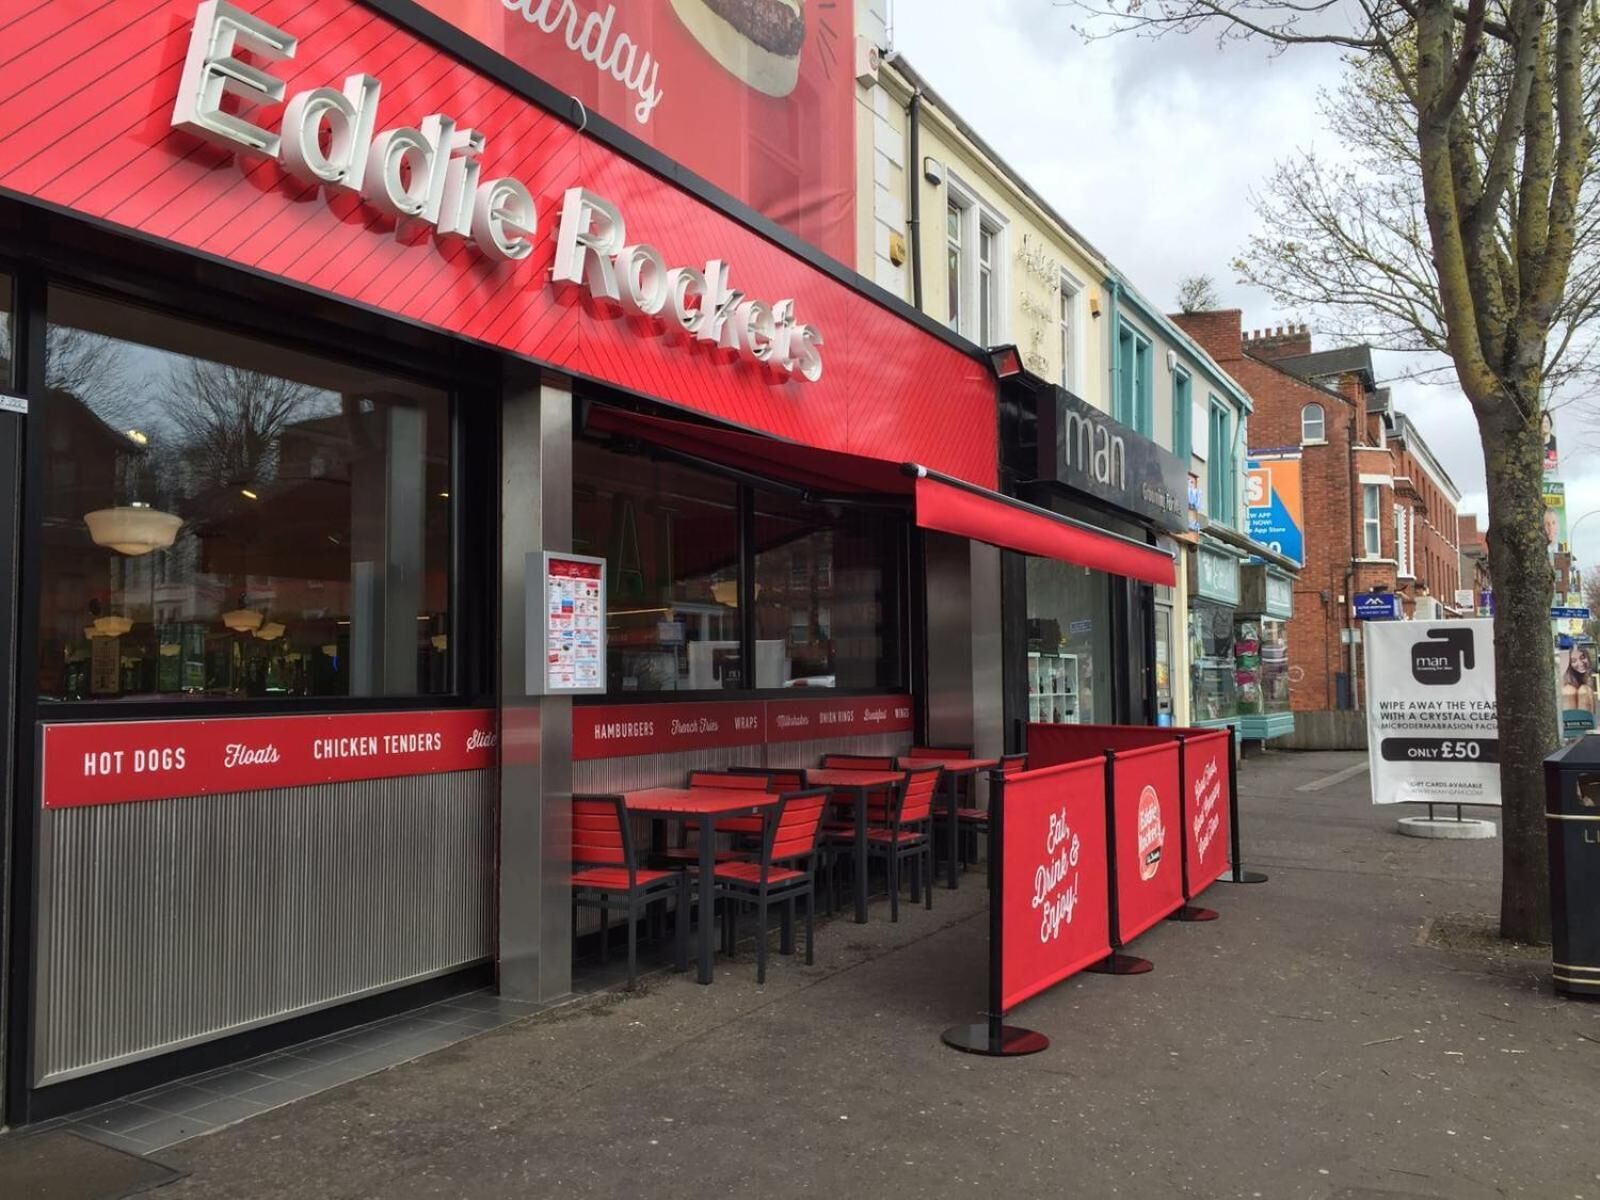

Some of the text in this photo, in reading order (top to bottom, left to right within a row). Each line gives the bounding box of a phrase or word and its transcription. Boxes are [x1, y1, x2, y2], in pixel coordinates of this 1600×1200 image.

[171, 0, 823, 382] Eddie Rockets
[1066, 409, 1125, 491] man
[1416, 657, 1448, 667] man
[1379, 701, 1405, 710] WIPE
[1408, 701, 1442, 710] AWAY
[1446, 701, 1466, 710] THE
[1380, 712, 1405, 720] WITH
[1408, 712, 1417, 720] A
[1420, 712, 1466, 720] CRYSTAL
[594, 721, 654, 739] HAMBURGERS
[671, 717, 720, 735] French Fries
[734, 716, 758, 731] WRAPS
[1380, 722, 1473, 730] MICRODERMABRASION
[224, 743, 281, 768] Floats
[314, 732, 441, 759] CHICKEN TENDERS
[1408, 741, 1480, 759] ONLY £50
[84, 747, 186, 776] HOT DOGS
[1047, 807, 1070, 855] Eat,
[1032, 833, 1080, 908] Drink &
[1041, 871, 1079, 943] Enjoy!
